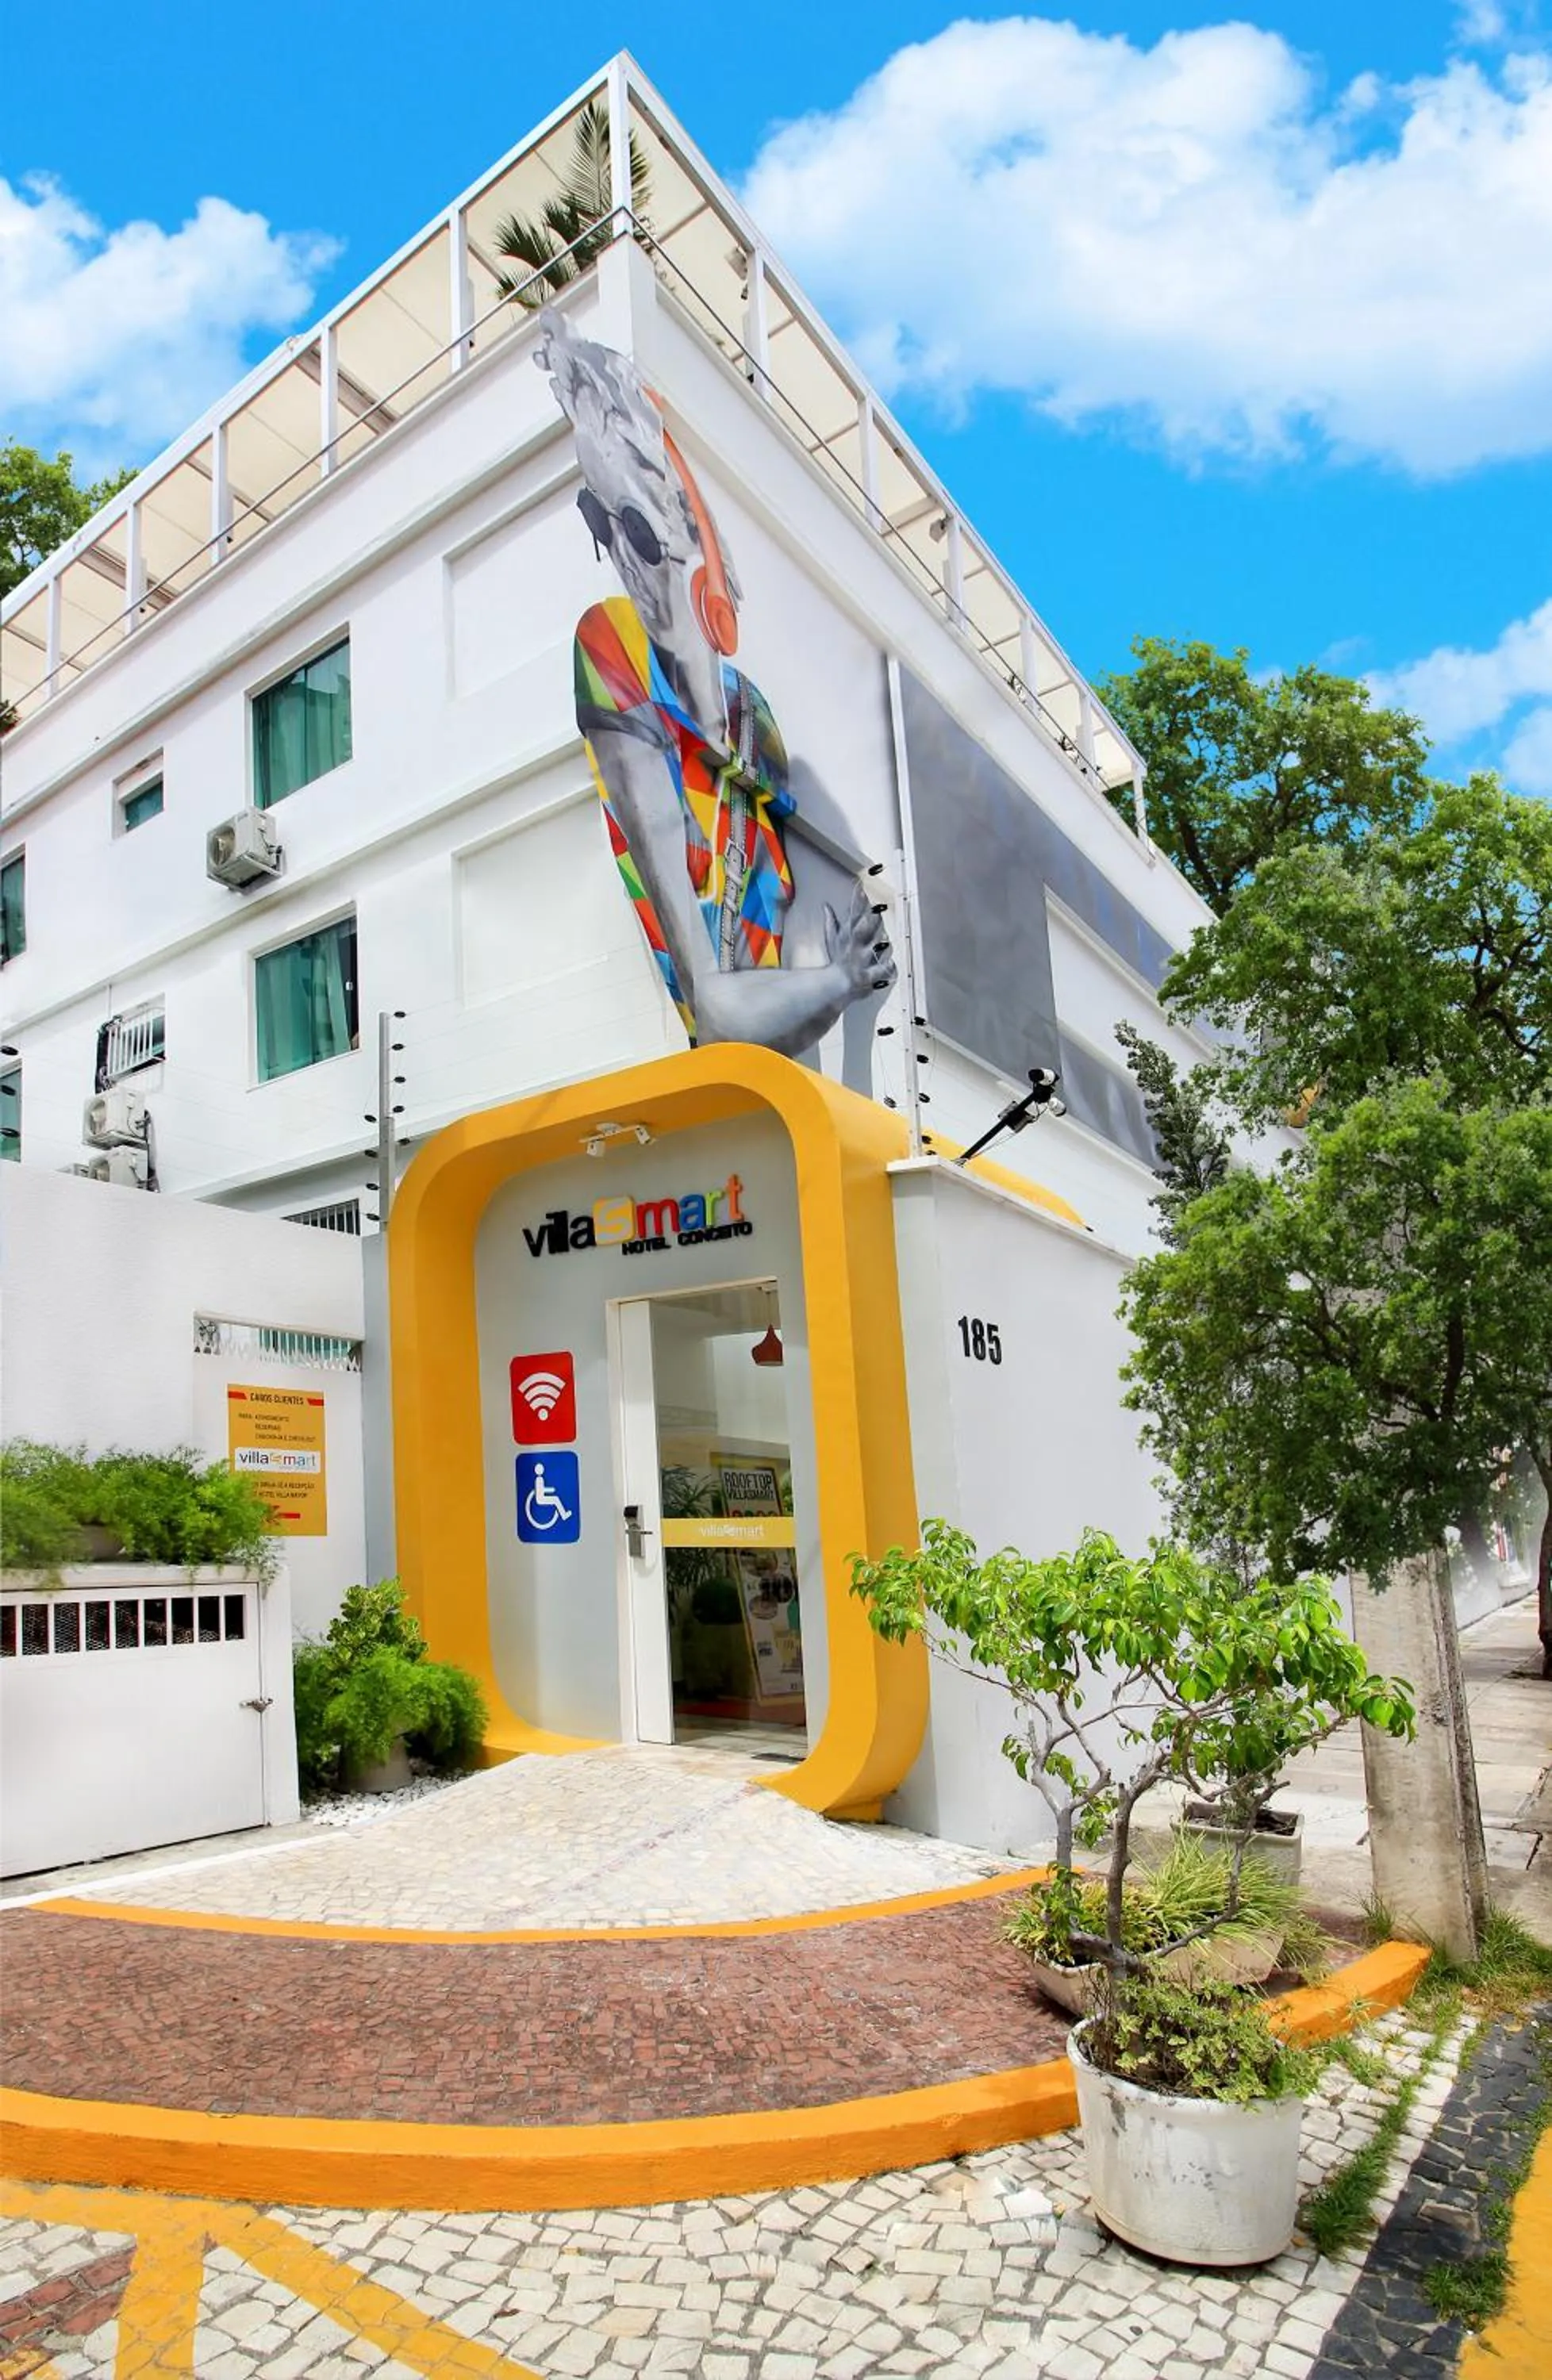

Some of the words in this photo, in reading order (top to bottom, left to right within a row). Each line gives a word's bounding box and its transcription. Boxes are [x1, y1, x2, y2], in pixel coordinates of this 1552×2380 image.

[621, 1235, 672, 1255] HOTEL
[677, 1221, 753, 1246] CONCEITO
[958, 1315, 1002, 1365] 185
[250, 1392, 272, 1403] CAROS
[274, 1395, 304, 1405] CLIENTES
[724, 1472, 772, 1490] ROOFTOP
